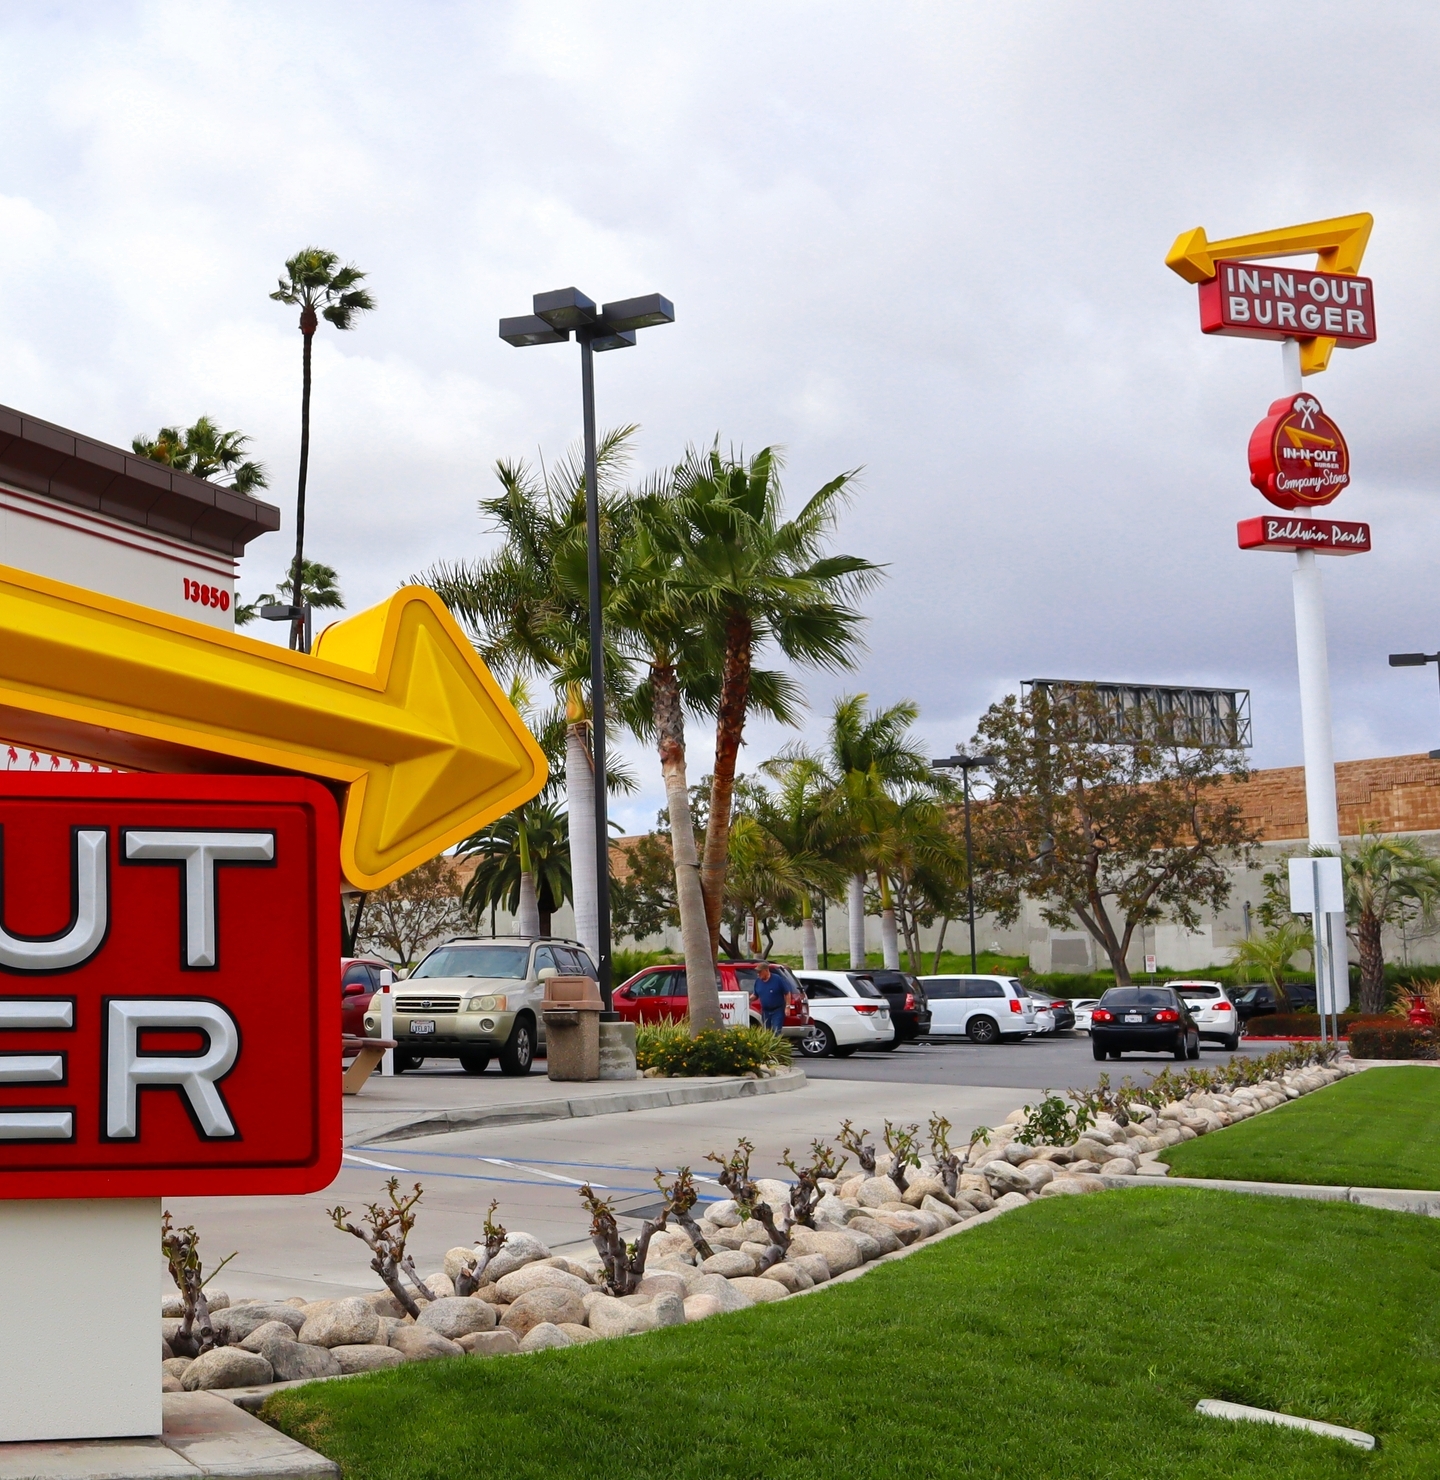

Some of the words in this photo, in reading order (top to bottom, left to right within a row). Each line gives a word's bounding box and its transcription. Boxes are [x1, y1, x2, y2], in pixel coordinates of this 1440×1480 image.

[1226, 267, 1367, 307] IN-N-OUT
[1229, 296, 1367, 335] BURGER
[1283, 447, 1338, 462] IN-N-OUT
[1314, 461, 1339, 469] BURGER
[1276, 472, 1323, 492] Company
[1323, 468, 1348, 486] Store
[1267, 520, 1329, 541] Baldwin
[1331, 525, 1366, 545] Park
[183, 577, 230, 612] 13850
[719, 1002, 735, 1010] ANK
